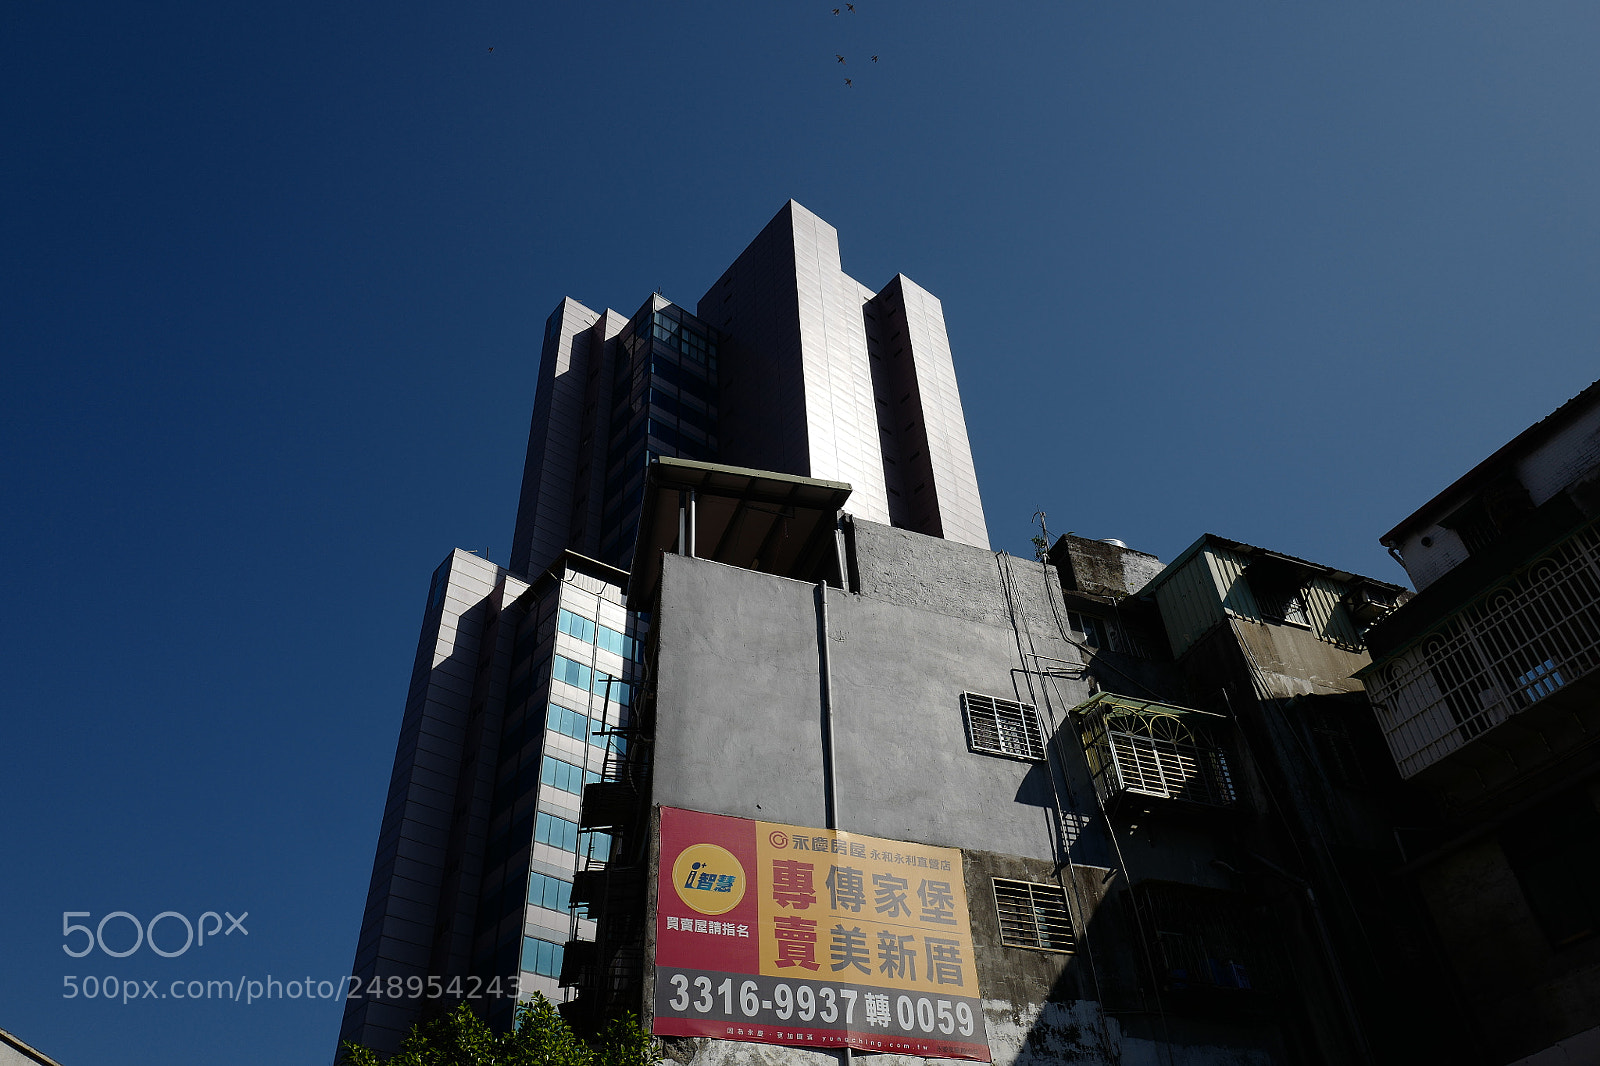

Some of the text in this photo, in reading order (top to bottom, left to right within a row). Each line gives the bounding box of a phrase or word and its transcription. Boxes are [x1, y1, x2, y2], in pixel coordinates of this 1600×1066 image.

[870, 850, 951, 871] 永和永利直營店
[825, 864, 957, 926] 傳家堡
[666, 916, 749, 938] 買賣屋請指名
